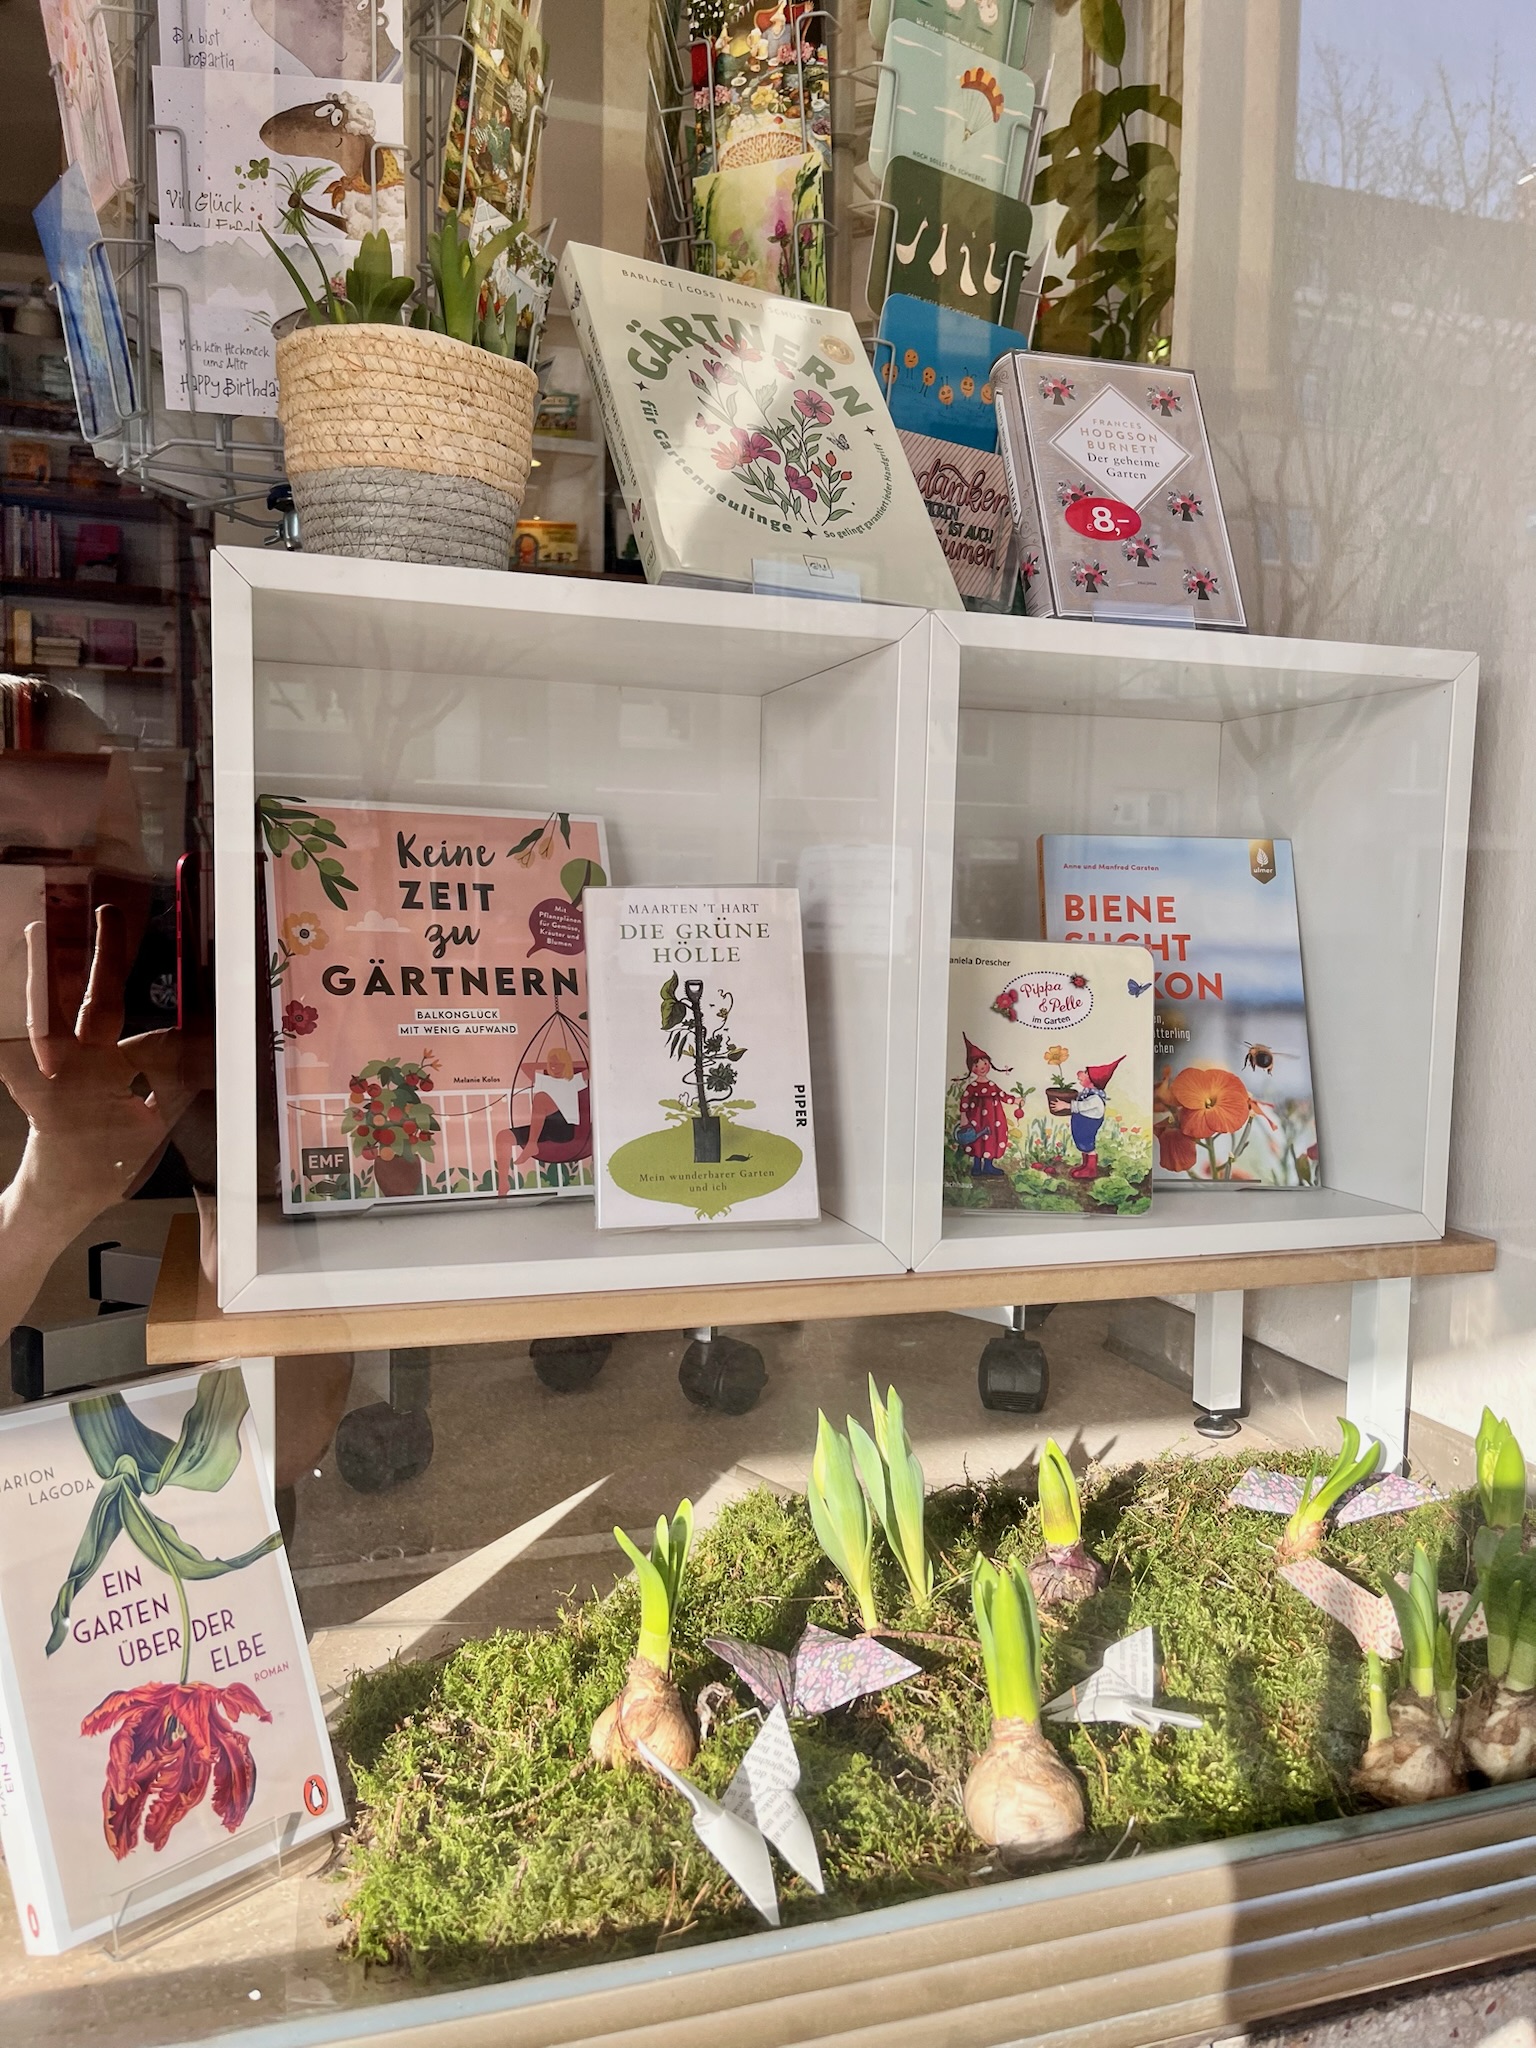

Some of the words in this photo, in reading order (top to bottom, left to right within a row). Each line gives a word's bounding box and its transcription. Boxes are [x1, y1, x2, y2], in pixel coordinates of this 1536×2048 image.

[198, 27, 221, 46] bist
[187, 51, 235, 71] roßartig
[166, 189, 191, 212] Vil
[194, 191, 244, 214] Glück
[621, 269, 676, 289] BARLAGE
[686, 285, 716, 298] GOSS
[727, 295, 758, 310] HAAS
[768, 306, 824, 326] SCHUSTER
[179, 339, 201, 352] Mch
[204, 341, 222, 353] kein
[225, 342, 270, 358] Heckmeck
[203, 358, 224, 369] ums
[226, 357, 249, 371] Alter
[626, 313, 874, 418] GÄRTNERN
[180, 373, 220, 399] Happy
[1092, 418, 1142, 429] FRANCES
[1080, 427, 1158, 443] HODGSON
[1087, 440, 1156, 455] BURNETT
[640, 399, 659, 425] für
[653, 427, 793, 533] Gartenneulinge
[873, 442, 893, 483] Handgriff
[1087, 452, 1108, 463] Der
[1113, 455, 1161, 468] geheime
[1105, 467, 1147, 480] Garten
[882, 483, 893, 504] jeder
[863, 501, 889, 531] garantiert
[823, 530, 836, 539] So
[837, 524, 866, 540] gelingt
[964, 524, 994, 544] AUCH
[396, 831, 496, 869] Keine
[1098, 863, 1129, 871] Manfred
[398, 880, 495, 911] ZEIT
[554, 905, 567, 913] Mit
[628, 904, 698, 914] MAARTEN
[721, 903, 759, 914] HART
[1064, 894, 1177, 923] BIENE
[539, 928, 565, 938] Kräuter
[551, 922, 581, 933] Gemüse,
[619, 924, 665, 940] DIE
[675, 917, 770, 940] GRÜNE
[424, 923, 481, 959] zu
[546, 937, 573, 947] Blumen
[653, 941, 741, 964] HÖLLE
[950, 957, 973, 965] aniela
[975, 957, 1011, 967] Drescher
[321, 958, 580, 996] GÄRTNERN
[1019, 980, 1063, 998] Pippa
[1049, 995, 1084, 1013] Pelle
[400, 1026, 419, 1034] MIT
[423, 1025, 460, 1034] WENIG
[464, 1025, 517, 1034] AUFWAND
[1032, 1015, 1042, 1024] im
[1043, 1015, 1071, 1025] Garten
[1153, 1027, 1191, 1042] tterling
[794, 1084, 808, 1128] PIPER
[308, 1153, 344, 1169] EMF
[639, 1173, 665, 1183] Mein
[669, 1171, 736, 1181] wunderbarer
[739, 1169, 775, 1178] Garten
[689, 1183, 708, 1192] und
[712, 1182, 728, 1192] ich
[0, 1466, 55, 1493] ARION
[28, 1478, 95, 1506] LAGODA
[102, 1565, 143, 1598] EIN
[73, 1593, 170, 1644] GARTEN
[118, 1627, 183, 1667] ÜBER
[191, 1609, 236, 1643] DER
[210, 1632, 267, 1673] ELBE
[253, 1660, 290, 1683] ROMAN
